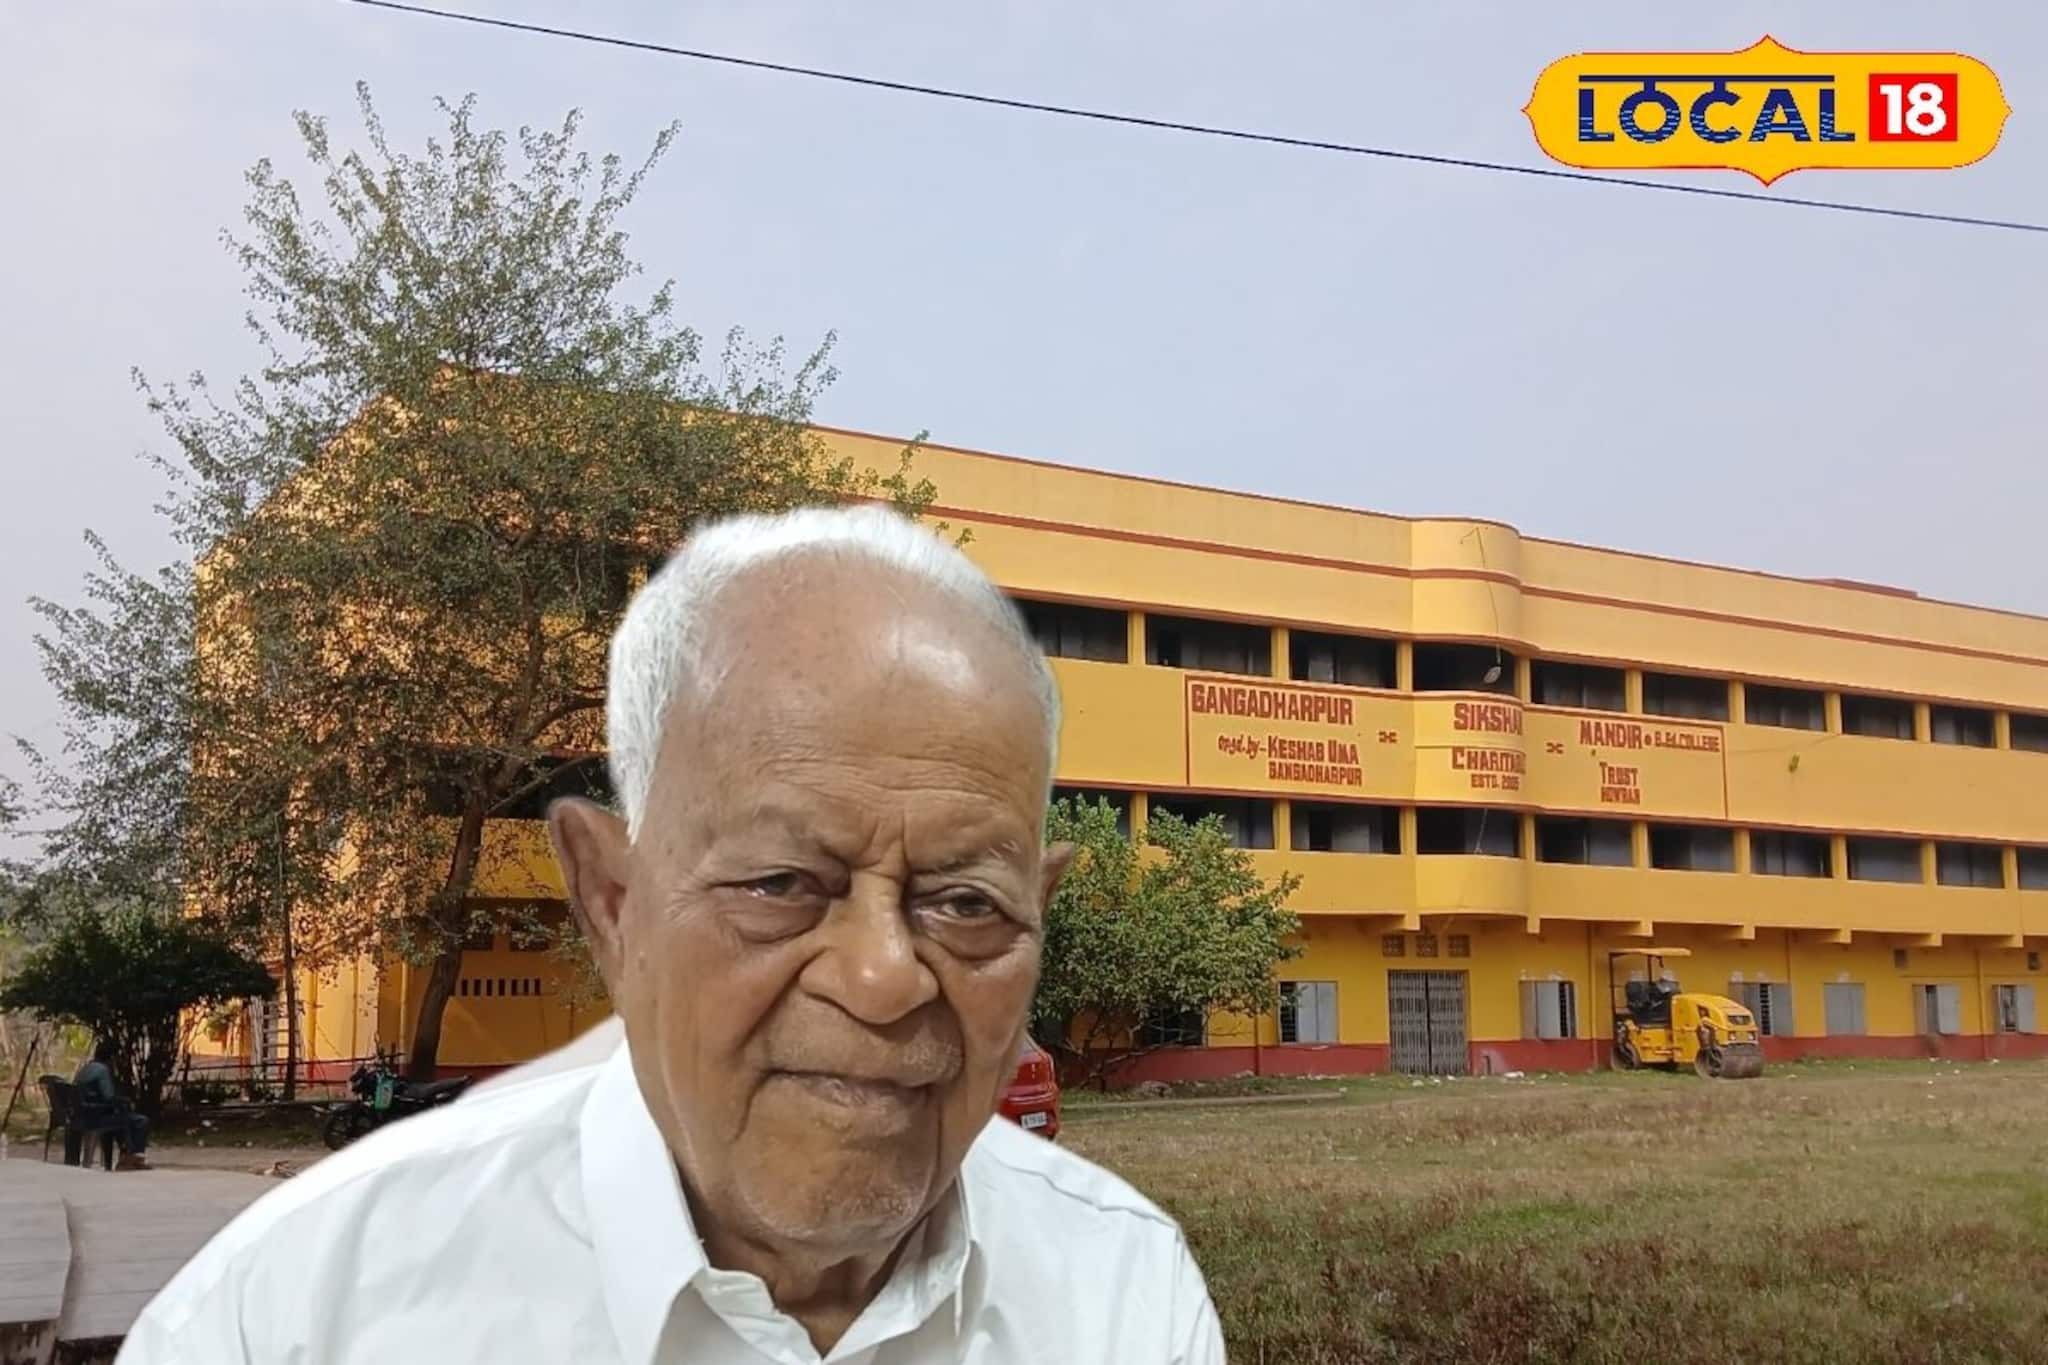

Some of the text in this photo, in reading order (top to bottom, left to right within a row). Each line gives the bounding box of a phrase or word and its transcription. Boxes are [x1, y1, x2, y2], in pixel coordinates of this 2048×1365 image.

[1191, 684, 1353, 725] GANGADHARPUR
[1454, 703, 1522, 735] SIKSHA
[1580, 720, 1643, 749] MANDIR
[1268, 735, 1325, 762] KESHAB
[1328, 739, 1359, 764] UMA
[1599, 762, 1638, 786] TRUST
[1268, 761, 1362, 786] GANGADHARPUR
